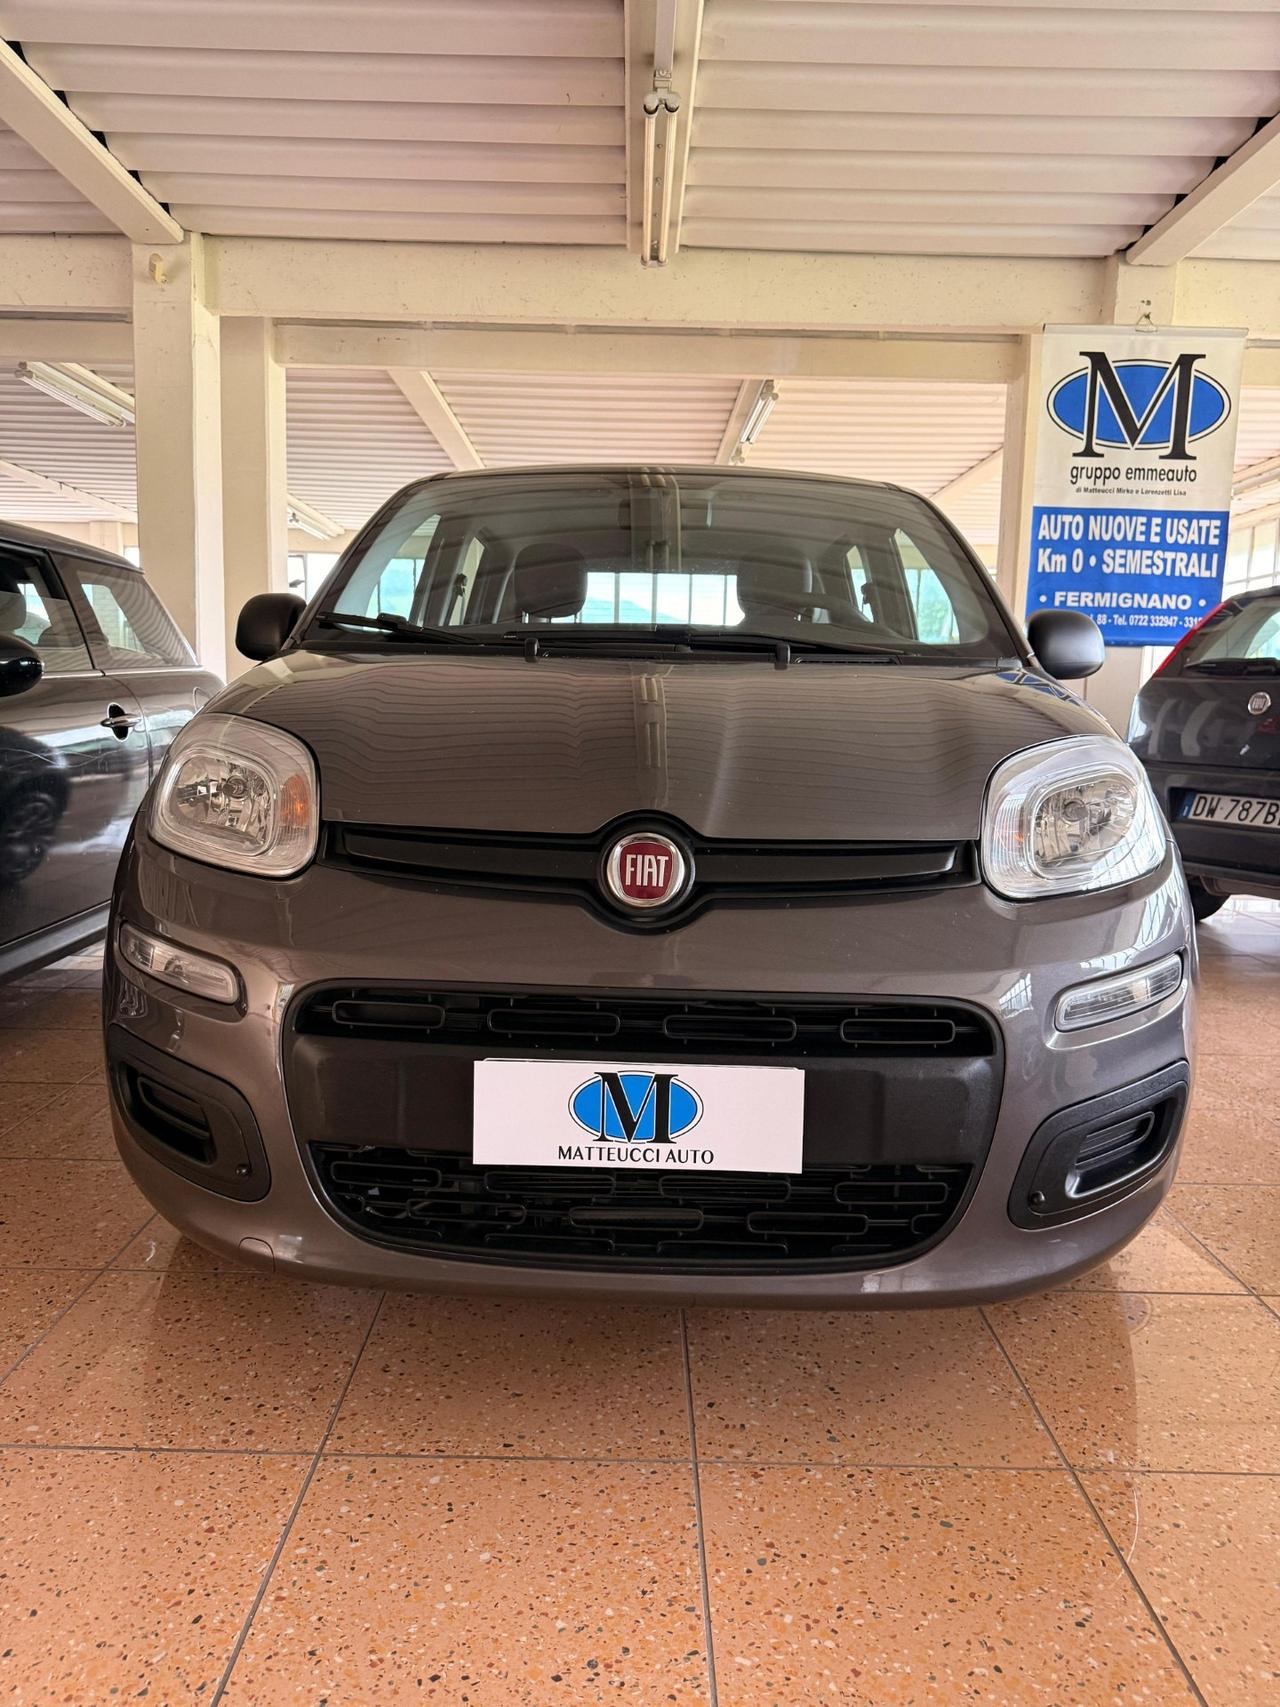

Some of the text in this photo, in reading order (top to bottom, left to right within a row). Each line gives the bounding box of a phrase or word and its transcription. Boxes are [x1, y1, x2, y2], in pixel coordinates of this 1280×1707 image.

[1072, 351, 1206, 460] M
[1070, 465, 1197, 486] gruppo emmeauto
[1037, 514, 1221, 545] AUTO NUOVE E USATE
[1037, 548, 1218, 578] Km 0 SEMESTRALI
[1054, 591, 1192, 610] FERMIGNANO
[1096, 613, 1107, 625] 88
[1112, 613, 1127, 626] Tel.
[1128, 614, 1148, 626] 0722
[1150, 614, 1179, 627] 332947
[1193, 796, 1280, 826] DW 787B
[625, 853, 669, 887] FIAT
[592, 1071, 678, 1144] M
[557, 1145, 715, 1165] MATTEUCCI AUTO
